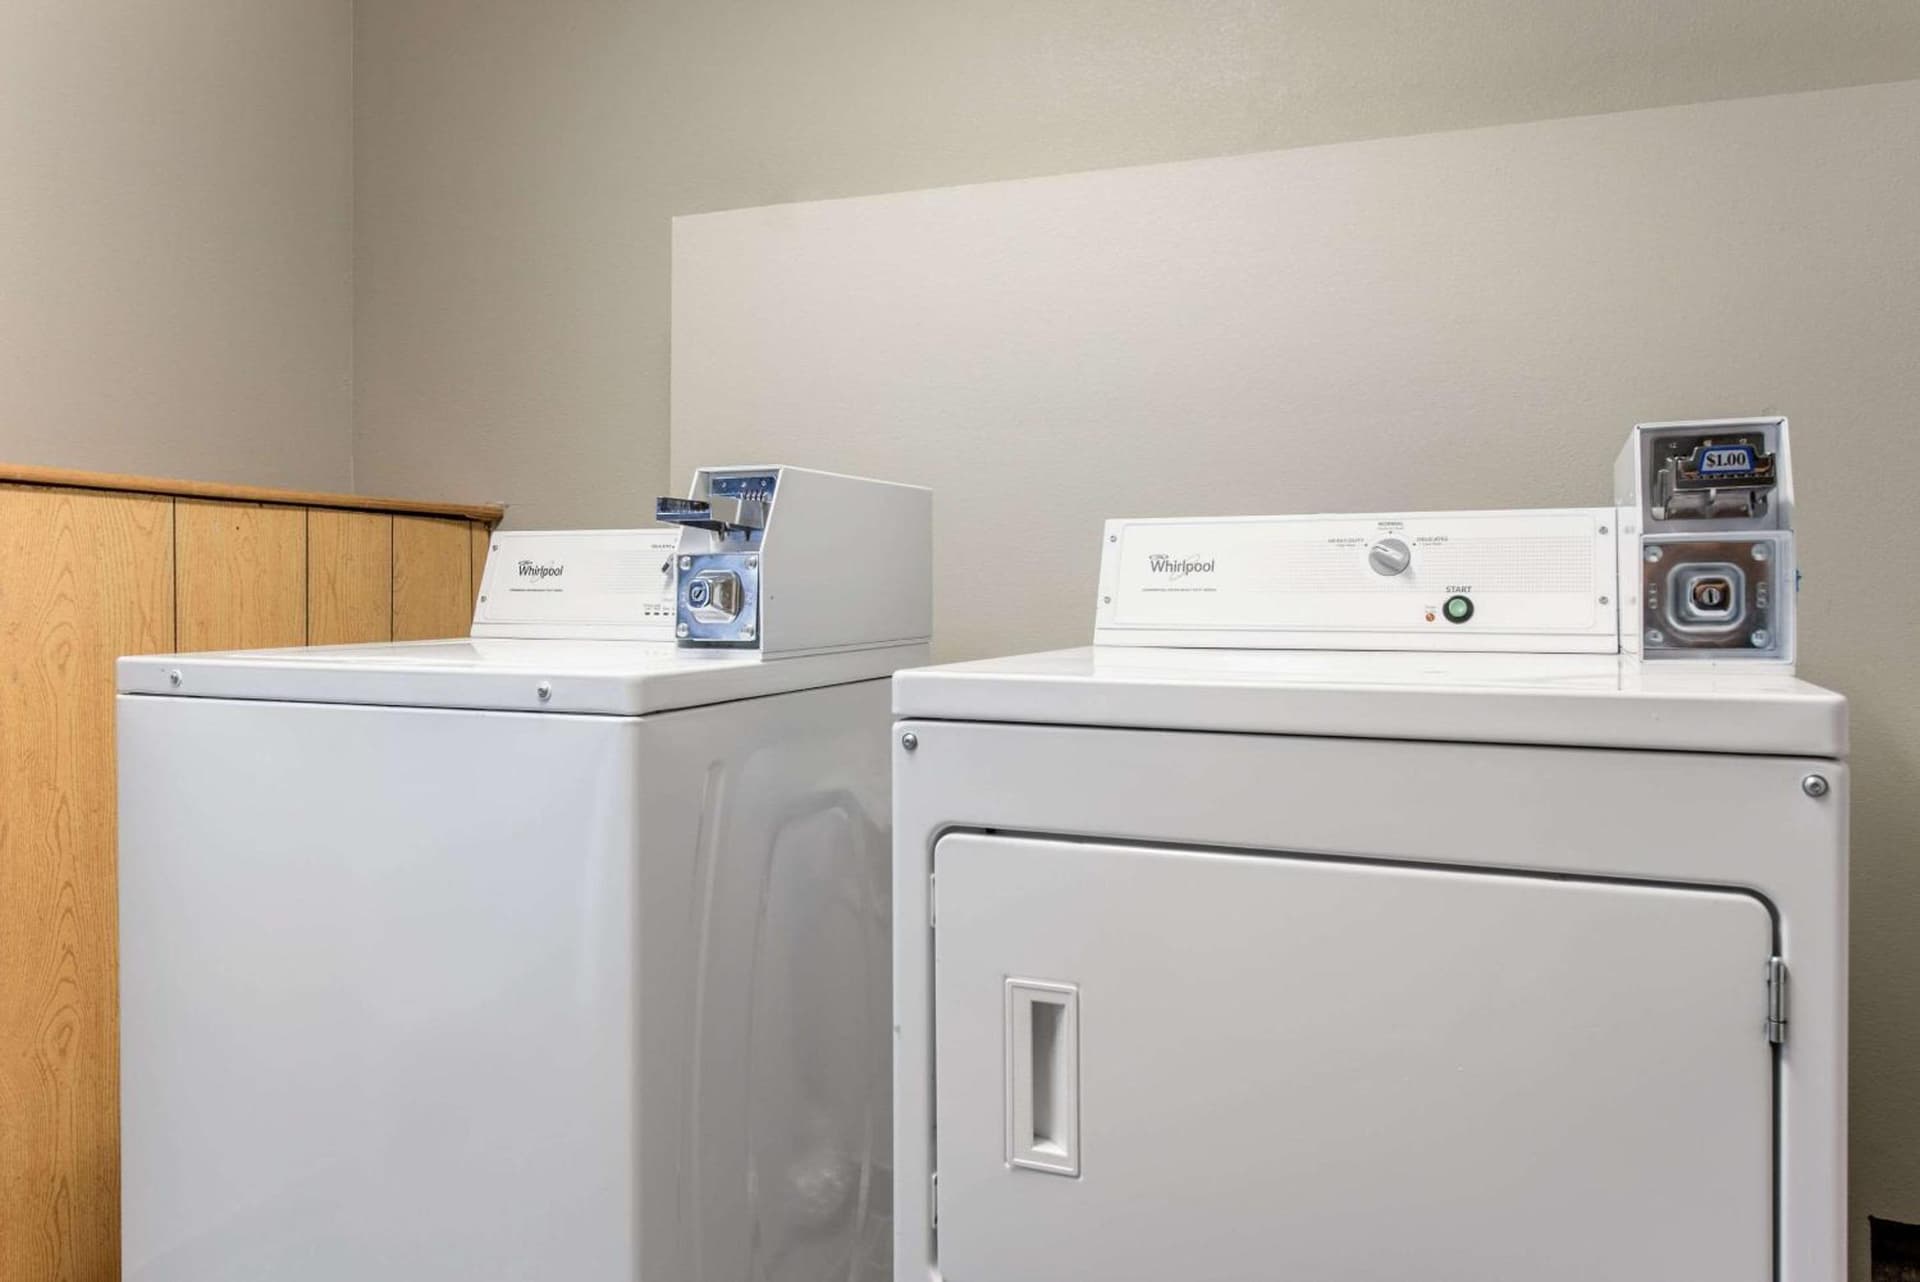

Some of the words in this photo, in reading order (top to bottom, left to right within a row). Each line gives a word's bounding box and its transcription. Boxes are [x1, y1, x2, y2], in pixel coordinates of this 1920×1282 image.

[1706, 452, 1746, 468] $1.00
[518, 564, 564, 579] Whirlpool
[1150, 559, 1215, 576] Whirlpool
[1446, 585, 1472, 593] START
